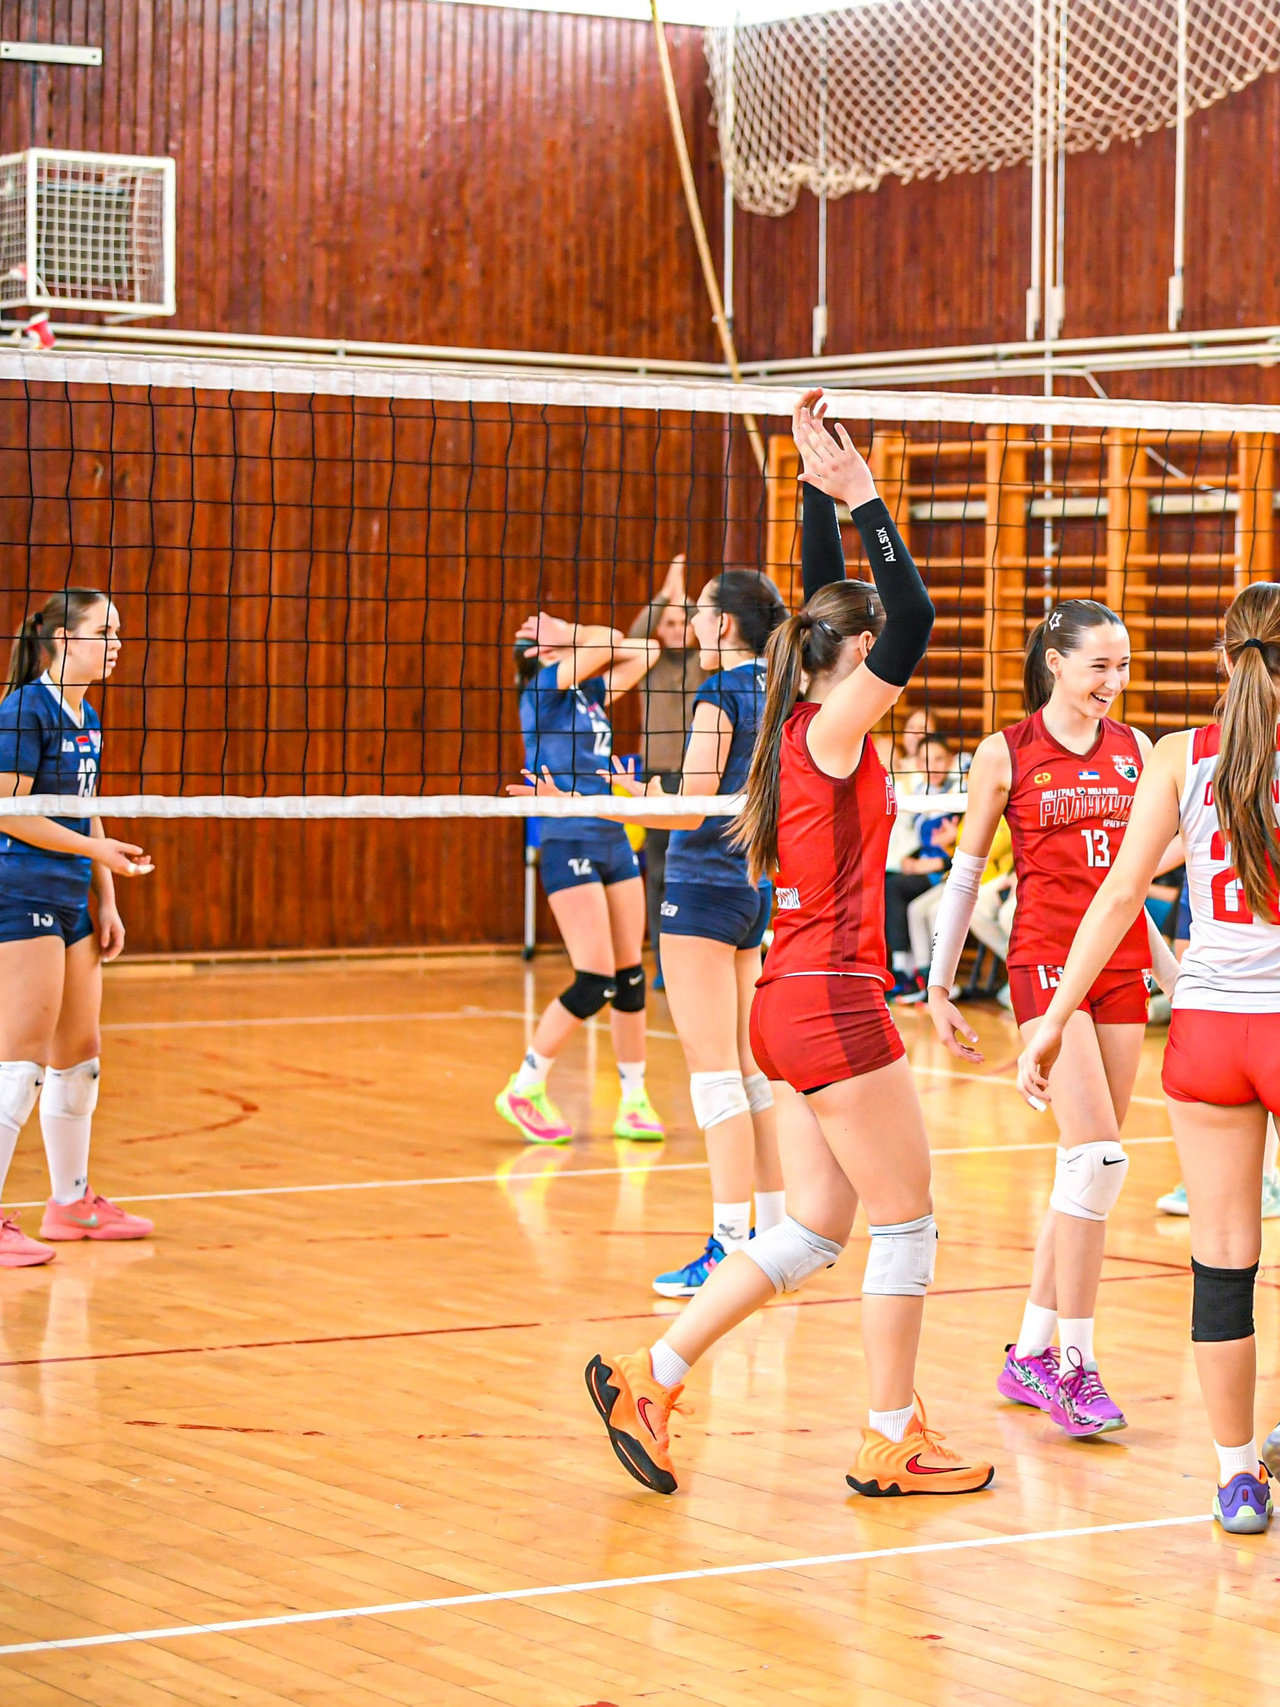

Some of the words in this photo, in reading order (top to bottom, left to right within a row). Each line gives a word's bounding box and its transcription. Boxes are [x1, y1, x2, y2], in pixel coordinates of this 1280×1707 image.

[876, 527, 896, 562] ALLSIX
[1040, 795, 1135, 827] РАДНИЧК
[1081, 829, 1110, 867] 13
